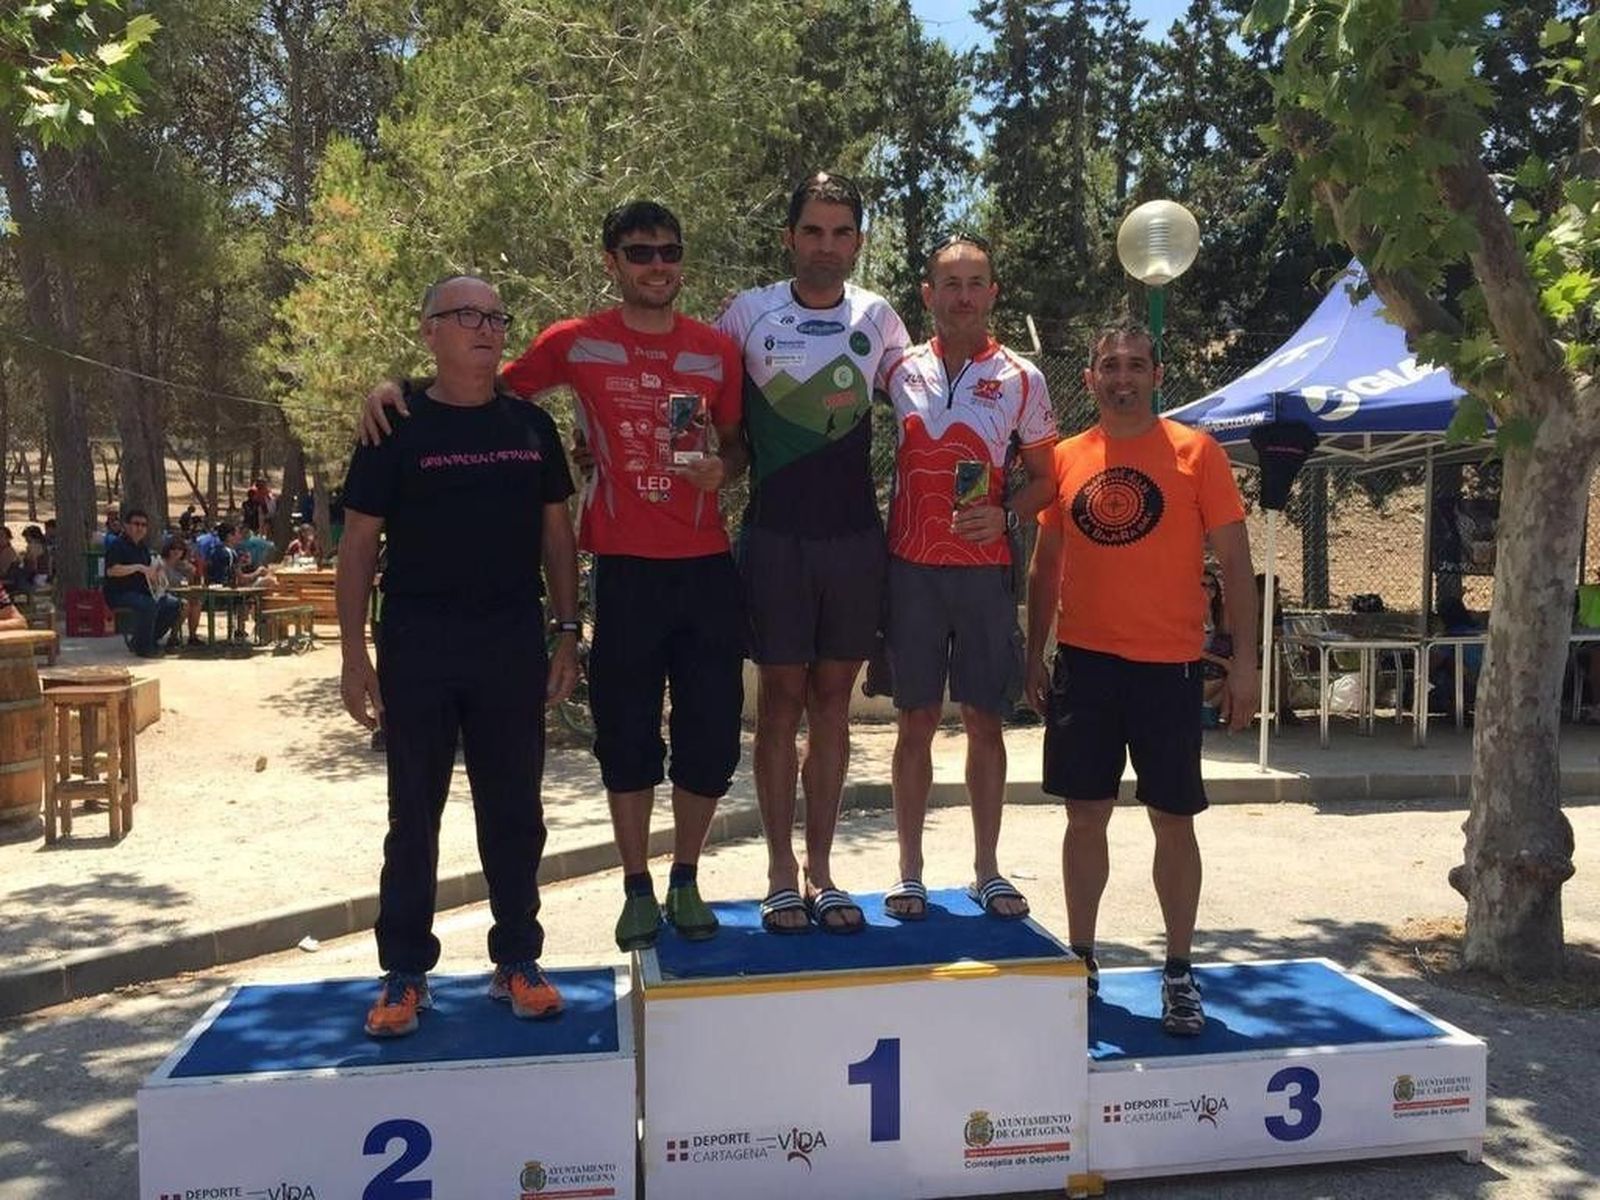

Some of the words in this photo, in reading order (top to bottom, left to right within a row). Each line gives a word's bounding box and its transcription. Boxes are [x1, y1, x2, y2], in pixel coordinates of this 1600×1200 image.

[637, 475, 671, 490] LED
[848, 1038, 901, 1142] 1
[1124, 1098, 1169, 1110] DEPORTE
[1264, 1066, 1322, 1142] 3
[995, 1114, 1071, 1128] AYUNTAMIENTO
[693, 1132, 751, 1147] DEPORTE
[996, 1130, 1009, 1139] DE
[1011, 1126, 1071, 1138] CARTAGENA
[778, 1128, 827, 1152] VIDA
[362, 1118, 432, 1200] 2
[693, 1148, 768, 1163] CARTAGENA
[1015, 1157, 1027, 1165] de
[1029, 1155, 1071, 1165] Deportes
[548, 1163, 616, 1175] AYUNTAMIENTO
[562, 1174, 615, 1184] CARTAGENA
[186, 1187, 242, 1200] DEPORTE
